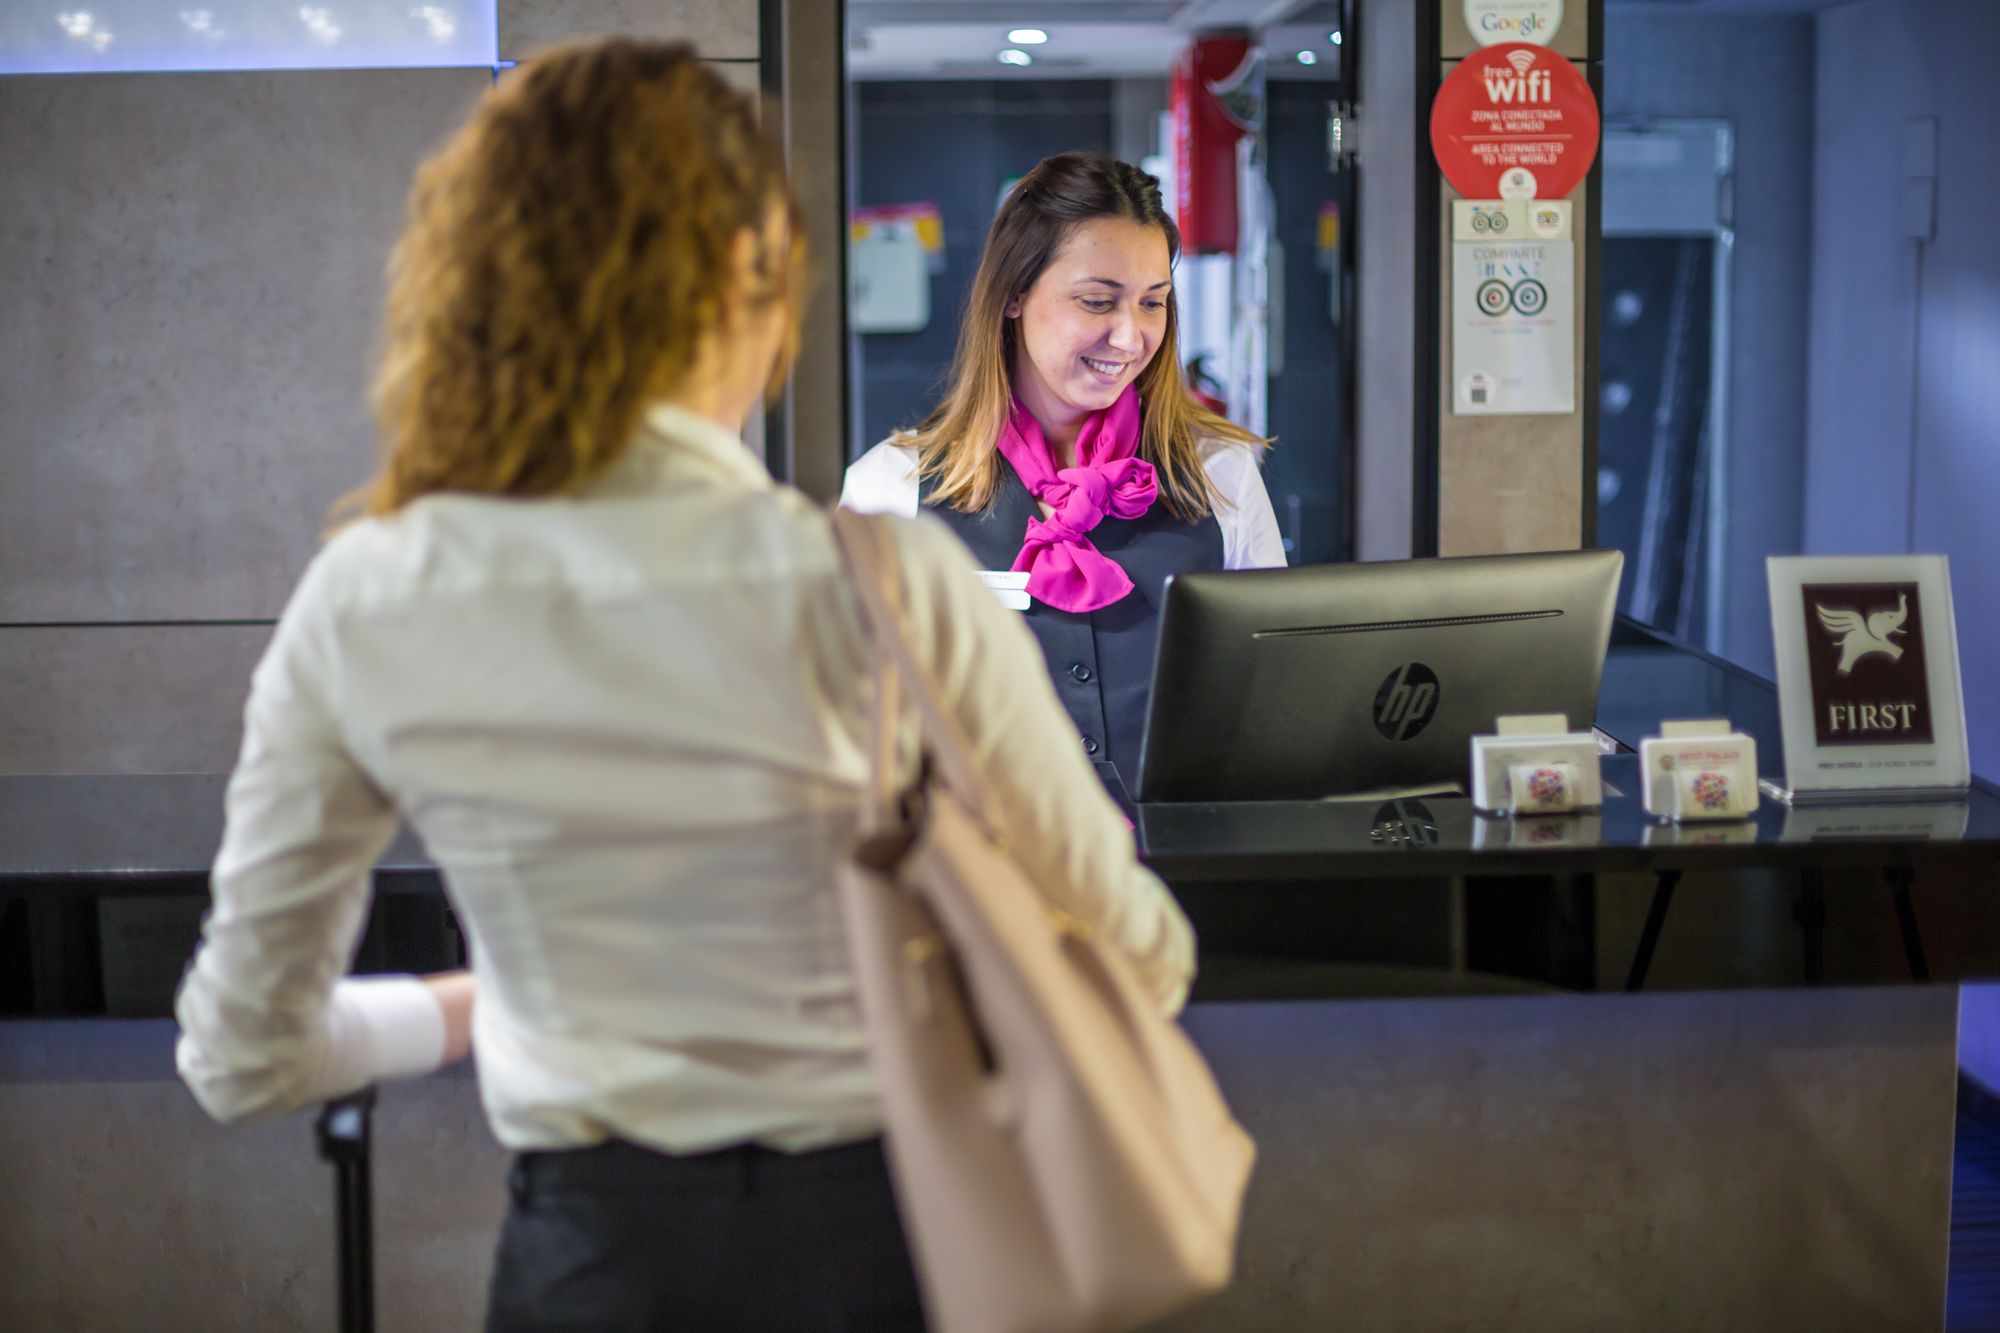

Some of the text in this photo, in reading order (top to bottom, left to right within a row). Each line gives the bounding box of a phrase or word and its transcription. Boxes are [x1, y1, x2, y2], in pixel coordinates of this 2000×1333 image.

[1481, 12, 1546, 36] Google
[1484, 65, 1512, 79] free
[1485, 70, 1551, 104] wifi
[1501, 109, 1562, 121] CONECTADA
[1505, 120, 1545, 131] MUNDO
[1471, 142, 1564, 154] AREA CONNECTED
[1498, 153, 1517, 164] THE
[1519, 152, 1557, 164] WORLD
[1473, 246, 1545, 260] COMPARTE
[1378, 665, 1435, 740] hp
[1829, 703, 1917, 732] FIRST
